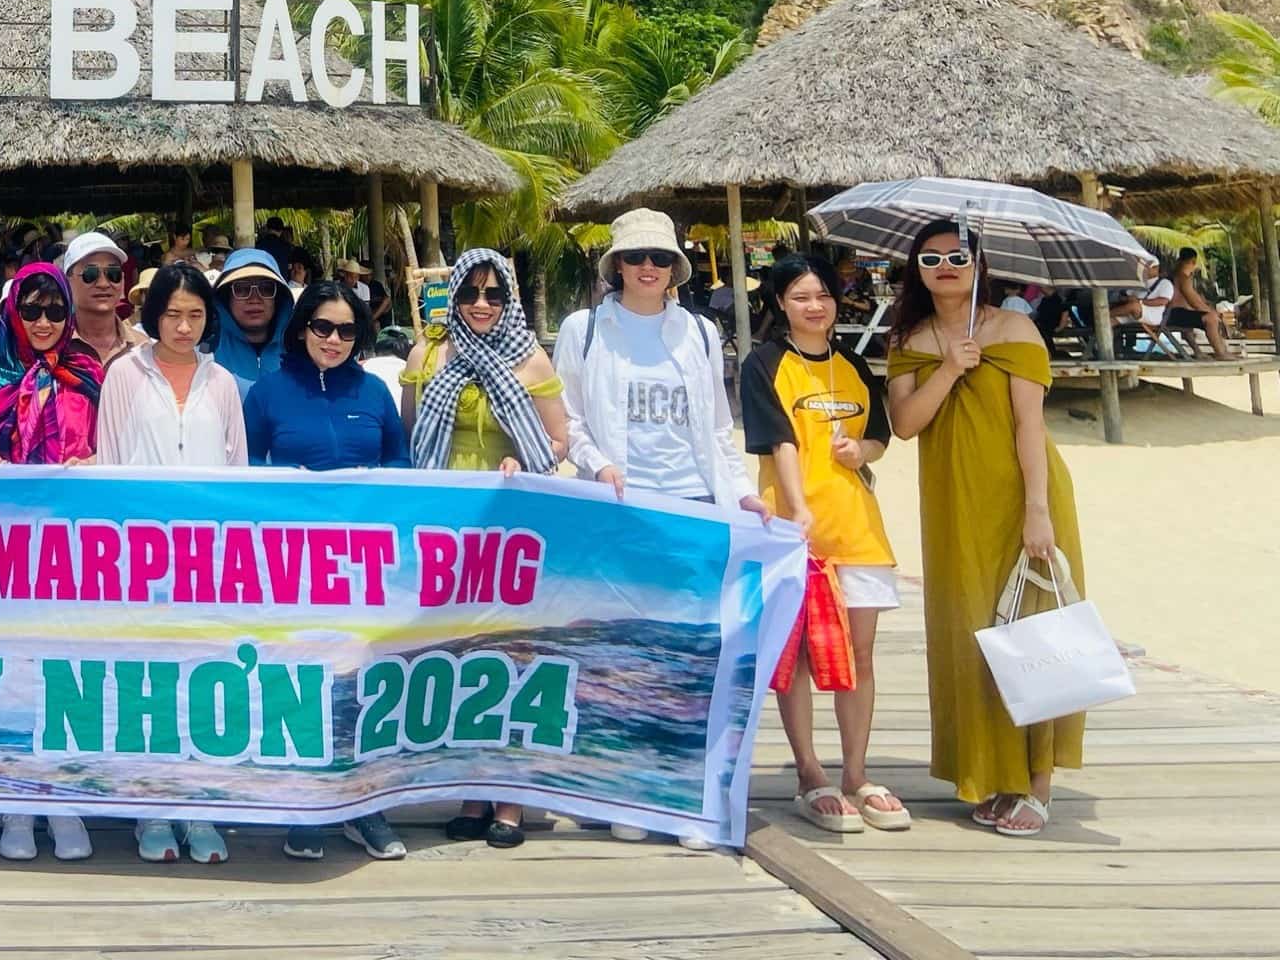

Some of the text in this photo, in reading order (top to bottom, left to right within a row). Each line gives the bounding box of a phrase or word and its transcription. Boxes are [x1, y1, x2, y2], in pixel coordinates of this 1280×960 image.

[417, 530, 542, 608] BMG
[41, 642, 331, 759] NHƠN
[359, 657, 575, 754] 2024
